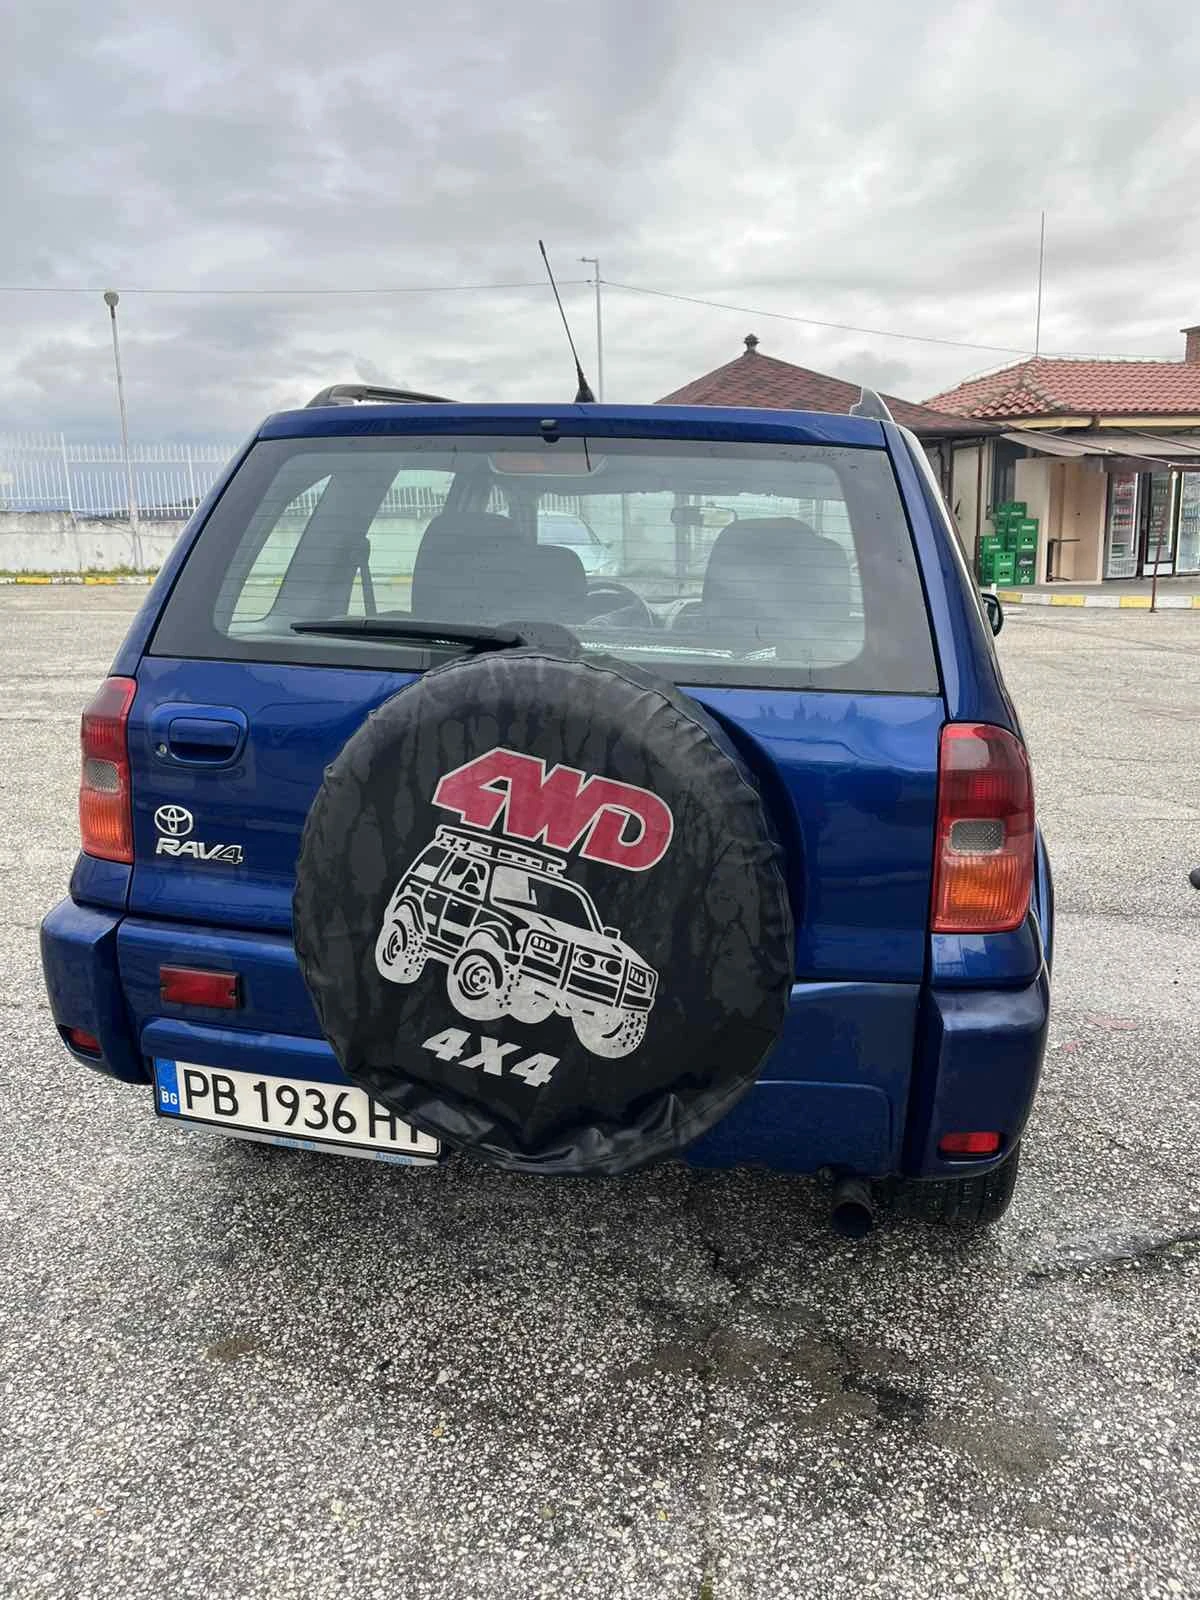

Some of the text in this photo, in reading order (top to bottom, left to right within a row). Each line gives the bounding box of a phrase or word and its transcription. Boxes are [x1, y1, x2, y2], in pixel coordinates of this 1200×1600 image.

[432, 747, 675, 872] 4WD
[155, 837, 244, 865] RAV4
[421, 1027, 560, 1088] 4X4
[161, 1090, 178, 1105] BG
[183, 1069, 239, 1117] PB
[253, 1081, 357, 1134] 1936
